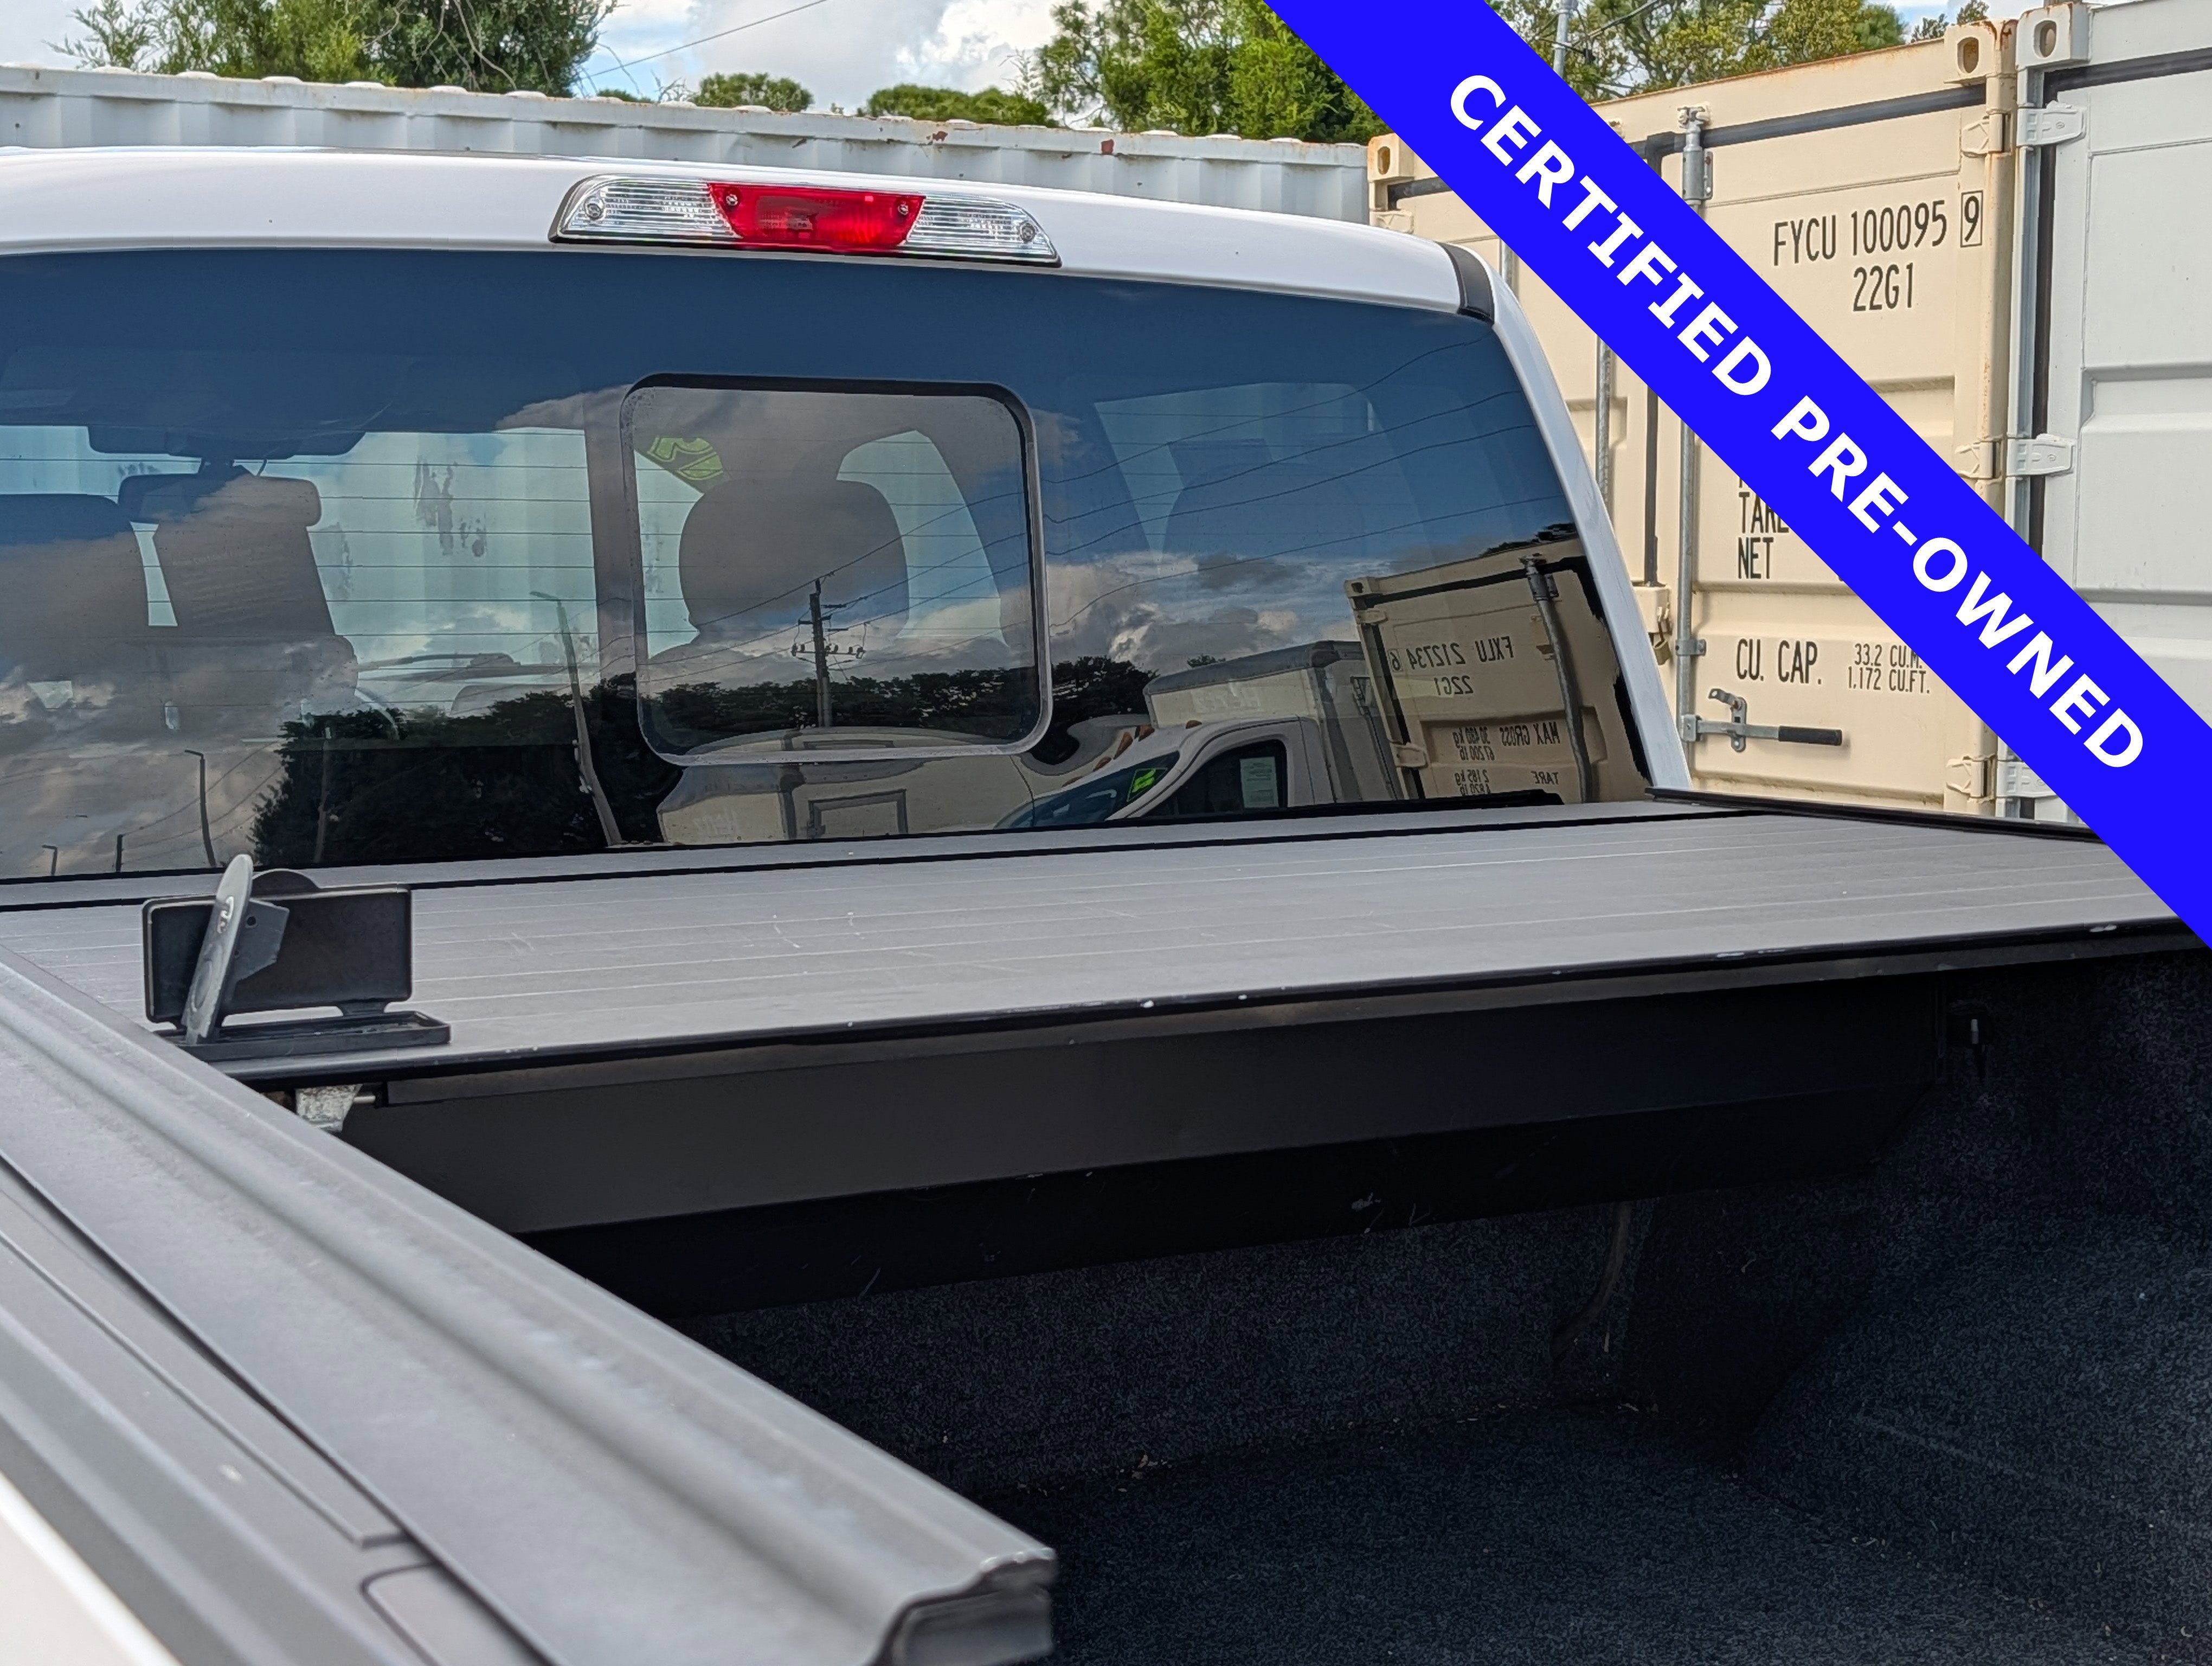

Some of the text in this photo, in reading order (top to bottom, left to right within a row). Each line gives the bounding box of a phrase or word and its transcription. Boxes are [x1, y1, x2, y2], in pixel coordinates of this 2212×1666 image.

[1773, 195, 1980, 266] FYCU 100095 9
[1853, 262, 1914, 312] 22G1
[1737, 537, 1774, 579] NET
[1736, 638, 1764, 681] CU.
[1778, 639, 1822, 684] CAP.
[1854, 643, 1882, 666] 33.2
